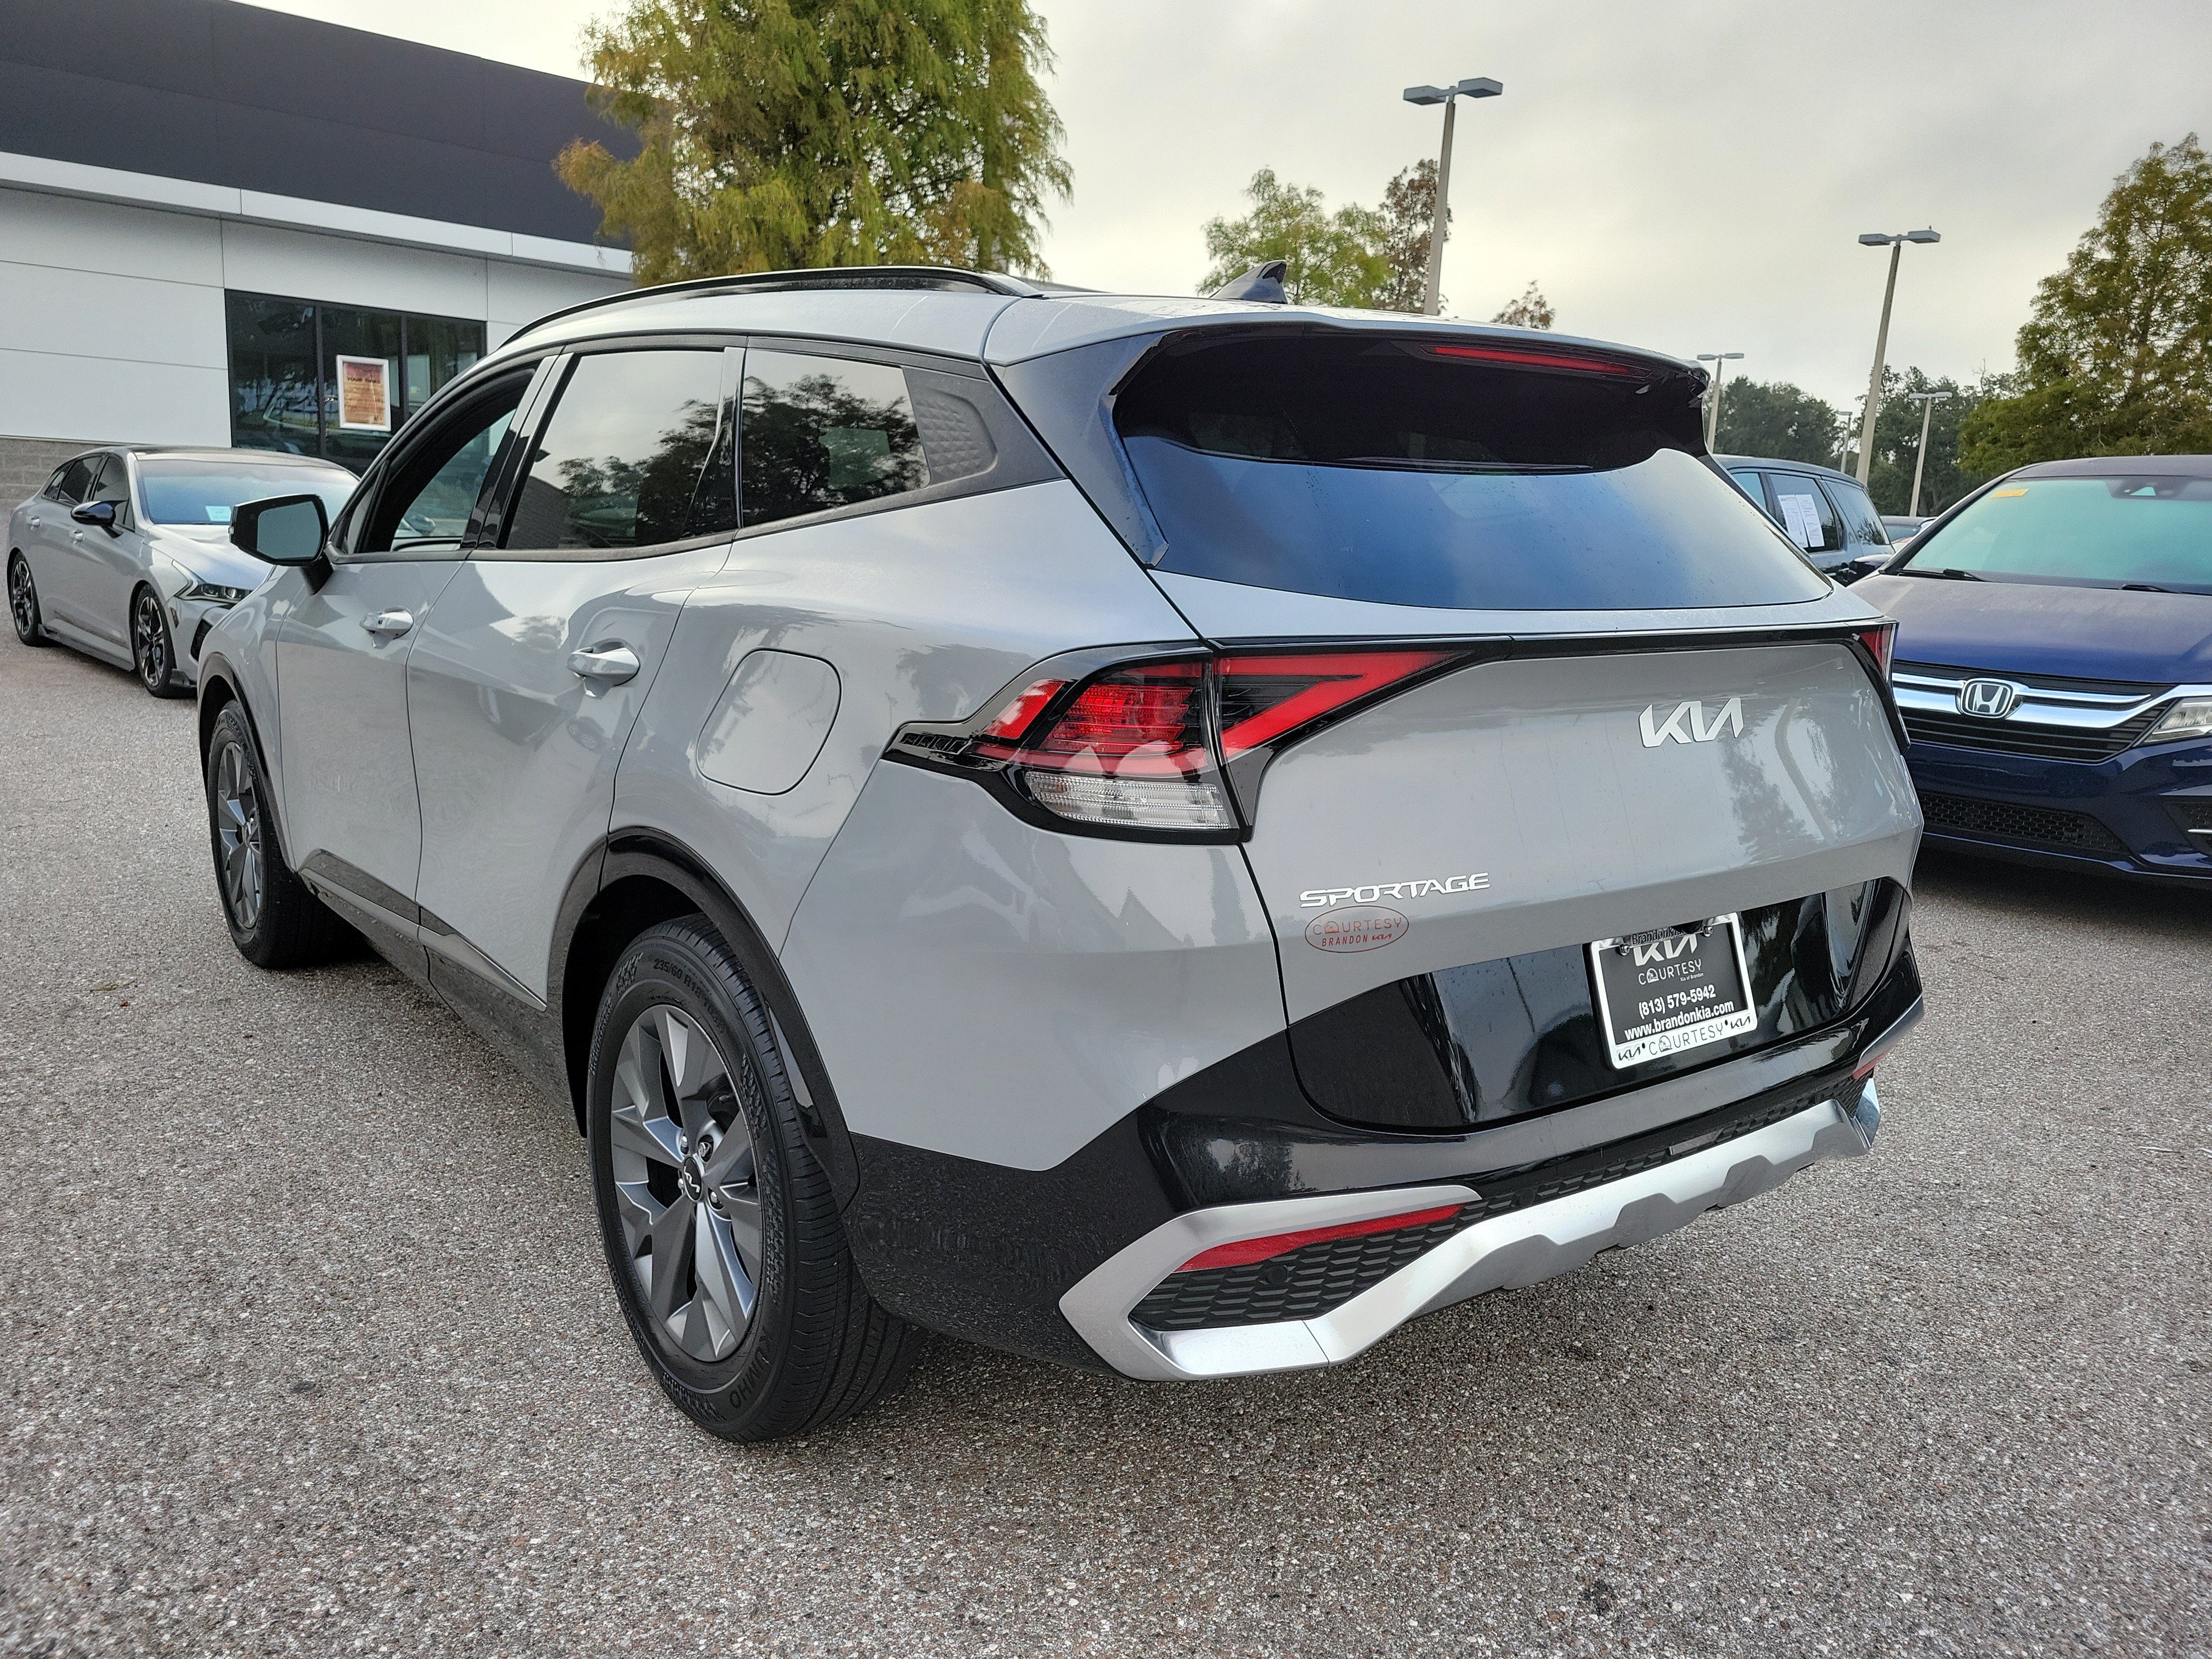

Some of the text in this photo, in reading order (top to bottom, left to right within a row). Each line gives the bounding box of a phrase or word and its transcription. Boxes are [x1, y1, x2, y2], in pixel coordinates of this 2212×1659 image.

[1639, 697, 1744, 748] KIA
[1300, 872, 1491, 907] SPORTAGE
[1313, 917, 1402, 935] COURTESY
[1322, 934, 1368, 947] BRANDON
[653, 958, 683, 980] 235/60
[1638, 958, 1702, 985] COURTESY
[1639, 984, 1716, 1020] (813) 579-5942
[1618, 1015, 1751, 1061] KIA COURTESY KIA
[1624, 1001, 1735, 1041] www.brandonkia.com
